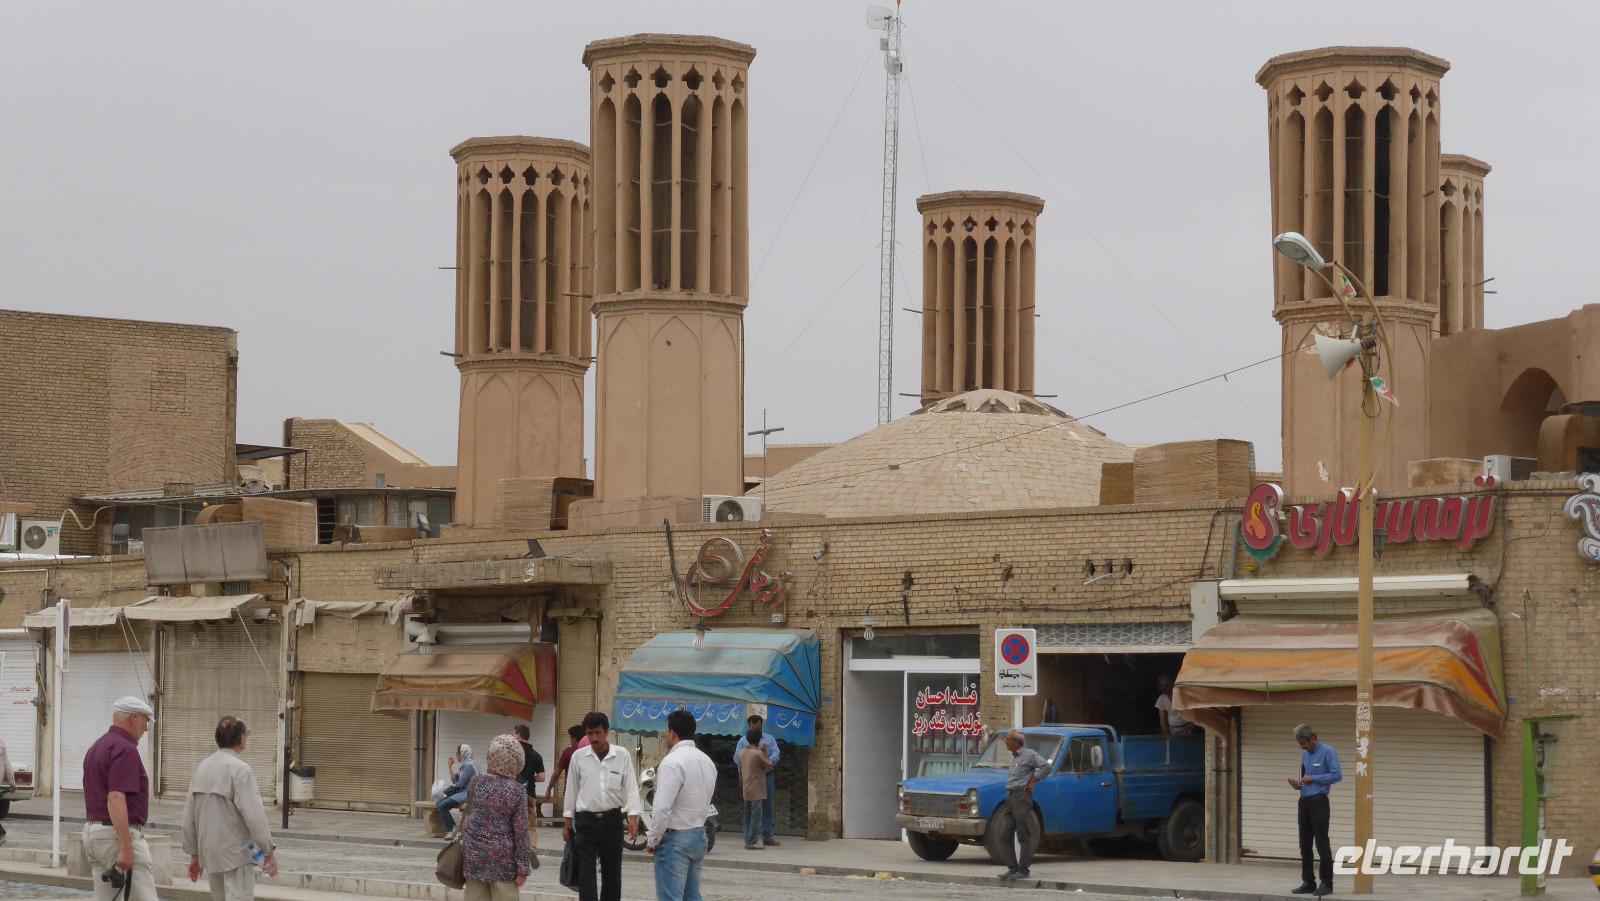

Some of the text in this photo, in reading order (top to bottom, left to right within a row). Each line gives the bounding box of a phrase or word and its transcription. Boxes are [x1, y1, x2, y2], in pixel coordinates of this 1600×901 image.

[1290, 475, 1498, 557] ترمه سلاری
[915, 682, 977, 709] قند احسان
